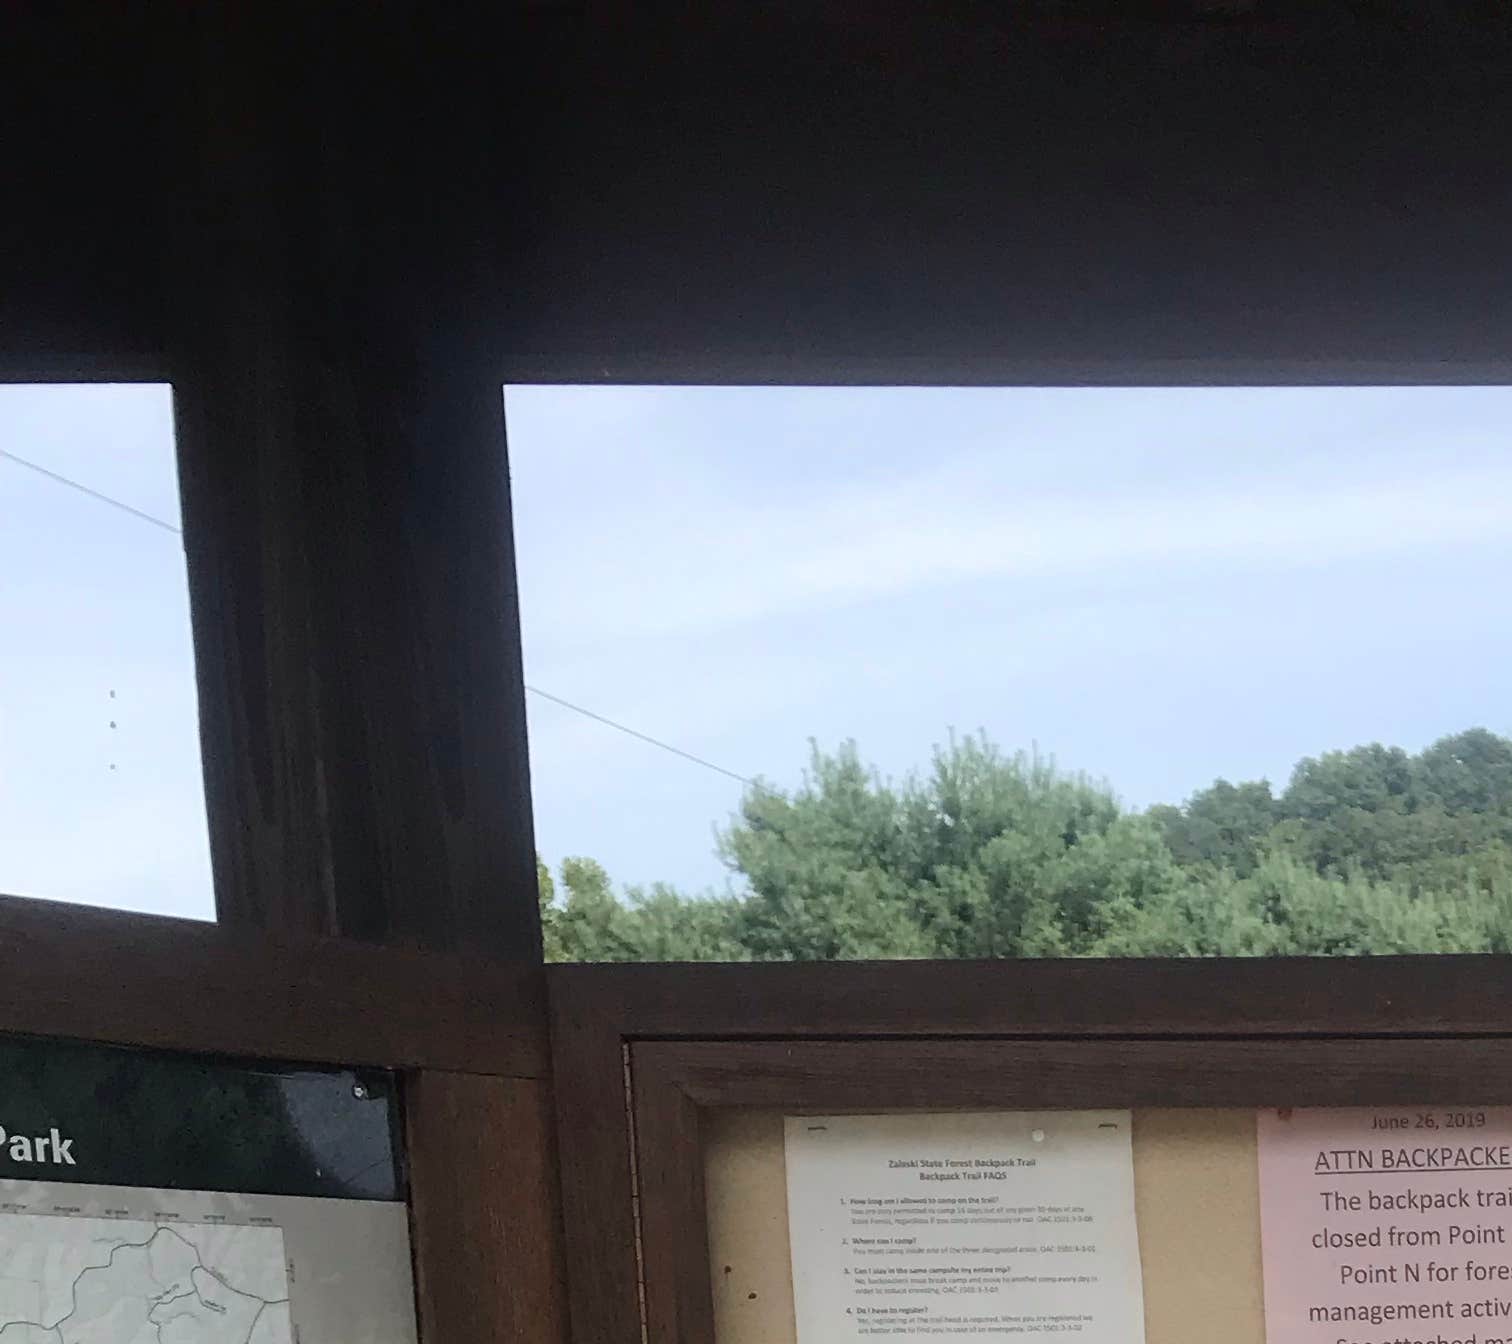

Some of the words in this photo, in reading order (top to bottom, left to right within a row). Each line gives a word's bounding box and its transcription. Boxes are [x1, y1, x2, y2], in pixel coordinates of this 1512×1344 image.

[1371, 1114, 1409, 1131] June
[1413, 1113, 1440, 1131] 26,
[1442, 1112, 1487, 1129] 2019
[1315, 1151, 1373, 1171] ATTN
[1320, 1191, 1361, 1212] The
[1369, 1187, 1470, 1212] backpack
[1312, 1226, 1381, 1249] closed
[1388, 1226, 1440, 1247] from
[1449, 1224, 1505, 1245] Point
[1341, 1264, 1397, 1285] Point
[1405, 1262, 1419, 1283] N
[1427, 1261, 1459, 1282] for
[1310, 1300, 1454, 1325] management
